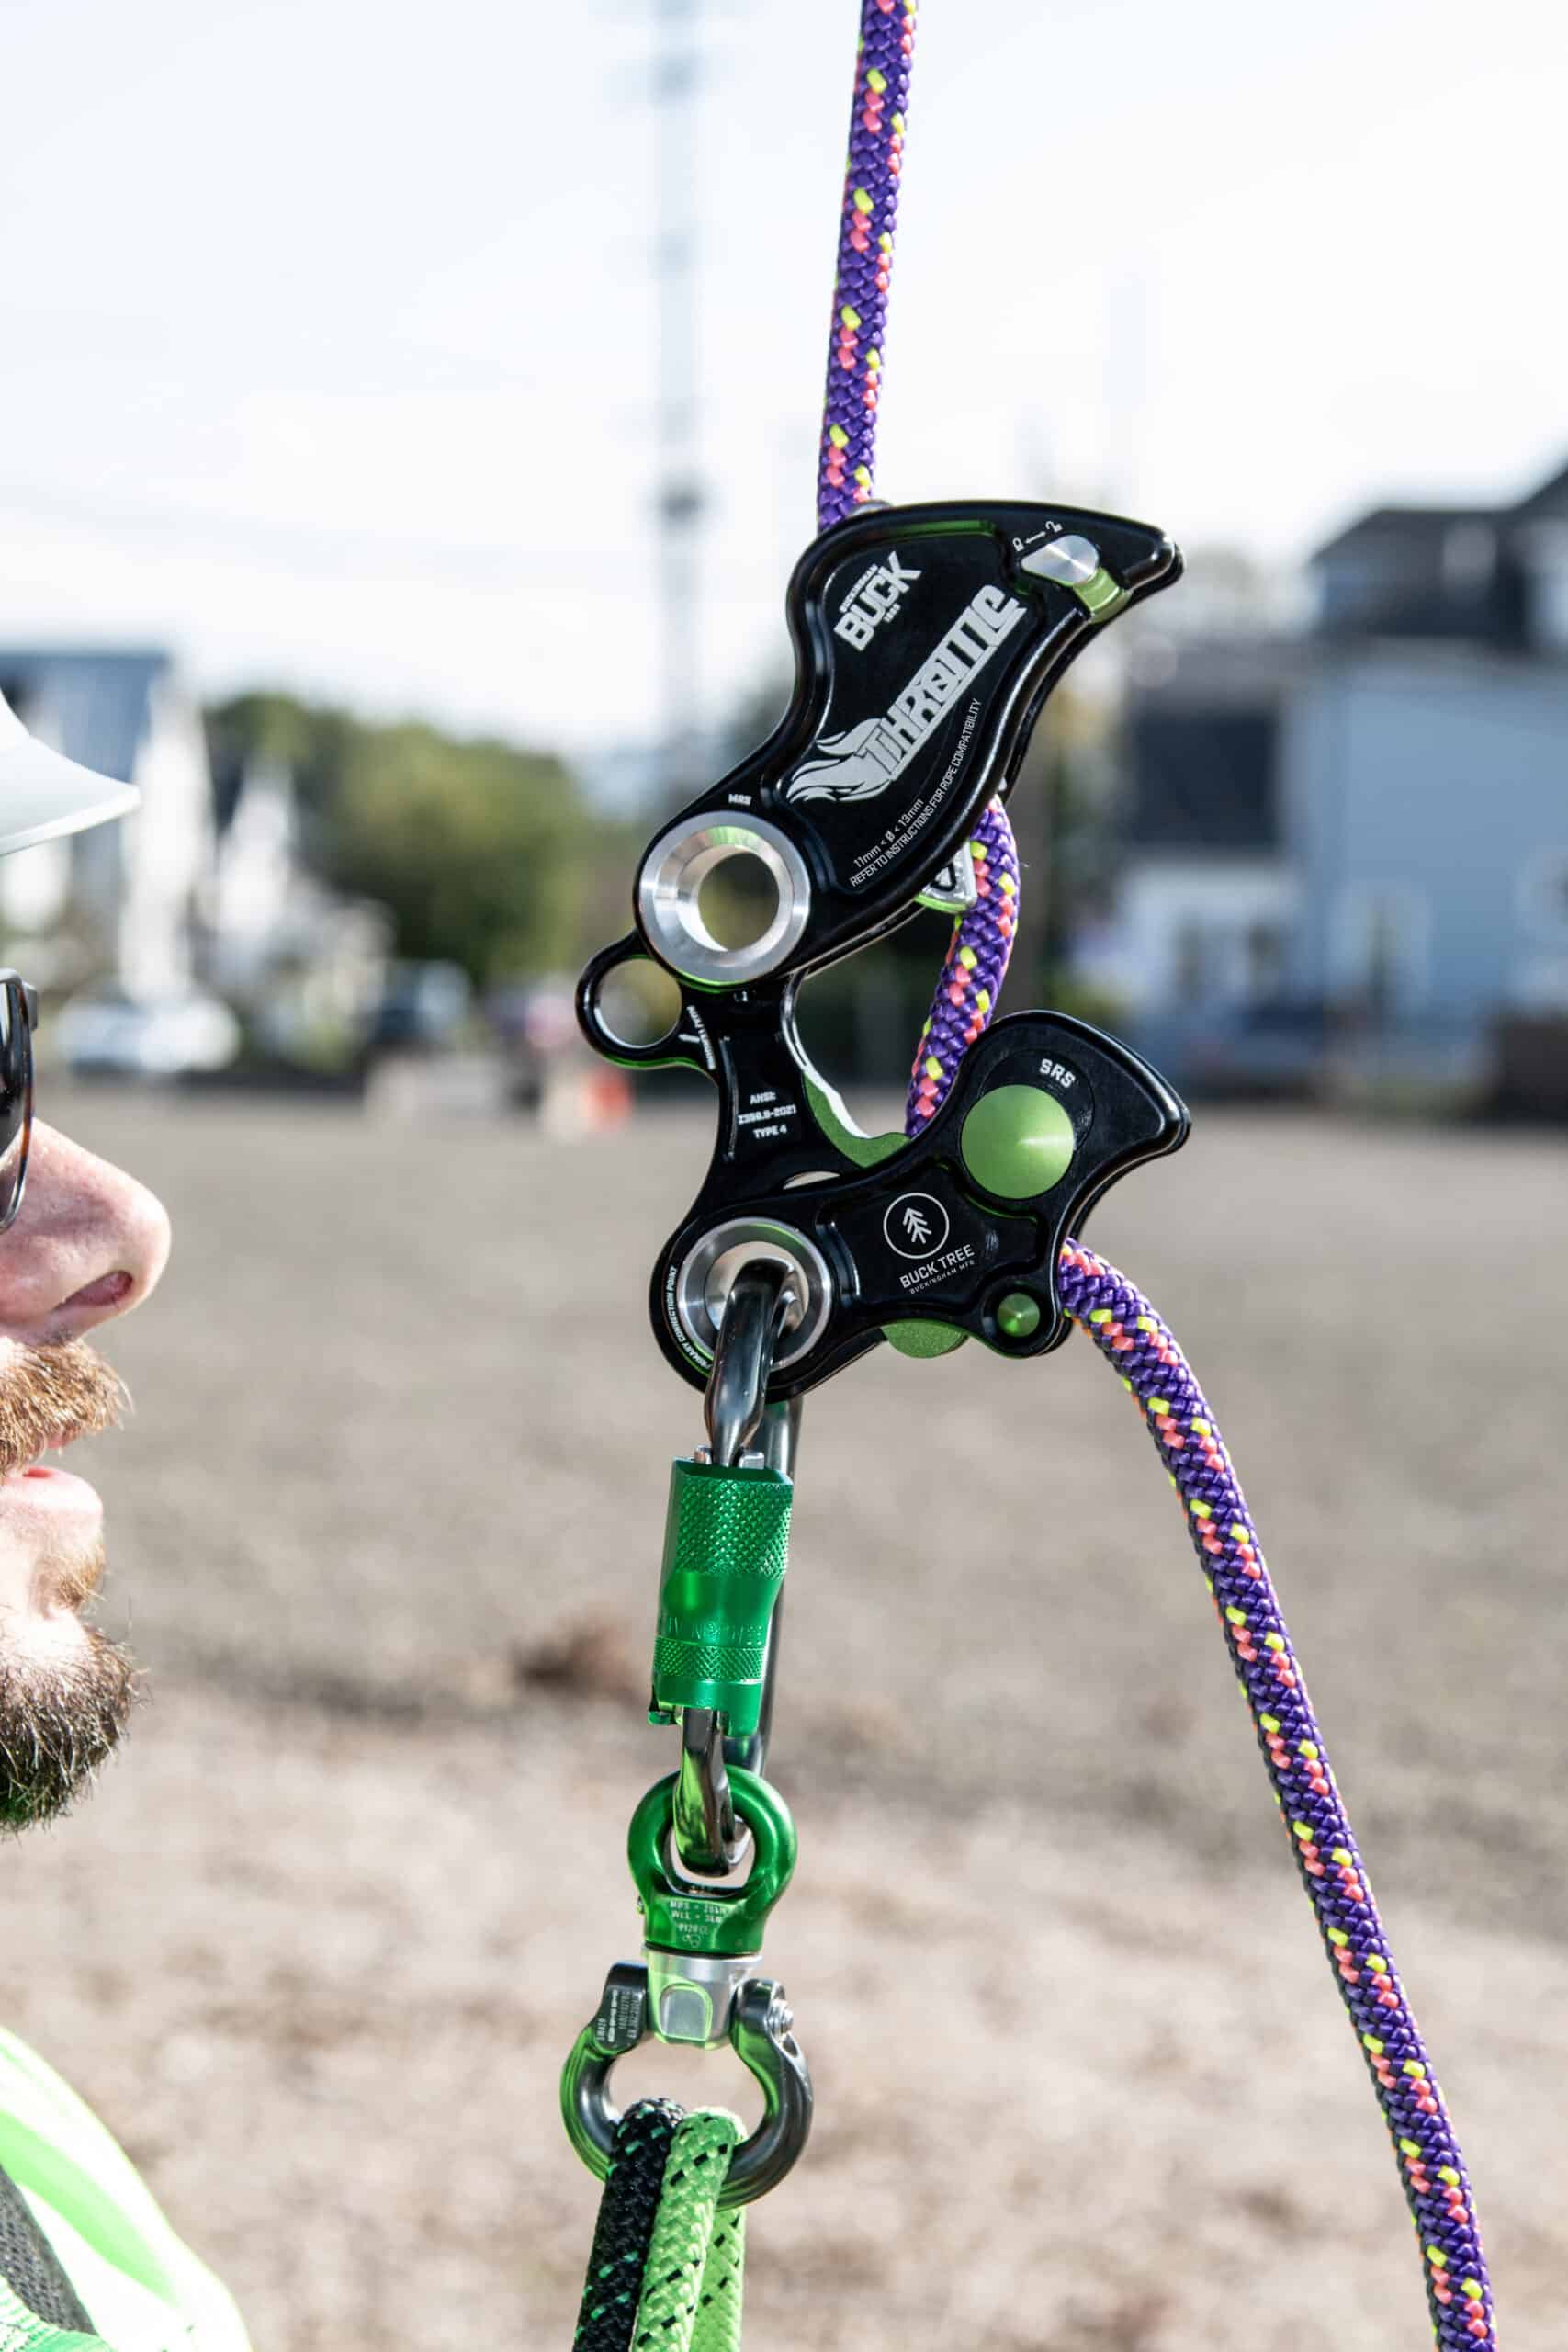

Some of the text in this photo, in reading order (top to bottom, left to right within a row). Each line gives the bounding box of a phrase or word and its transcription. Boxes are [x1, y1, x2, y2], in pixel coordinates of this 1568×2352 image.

[833, 550, 922, 651] BUCK
[849, 697, 983, 888] REFER TO INSTRUCTIONS FOR ROPE COMPATIBILITY
[853, 844, 882, 868] 11mm
[898, 797, 925, 827] 13mm
[1039, 1058, 1077, 1089] SRS
[753, 1124, 788, 1140] TYPE 4
[665, 1264, 678, 1291] POINT
[899, 1243, 976, 1289] BUCK TREE
[909, 1267, 957, 1295] BUCKINGHAM
